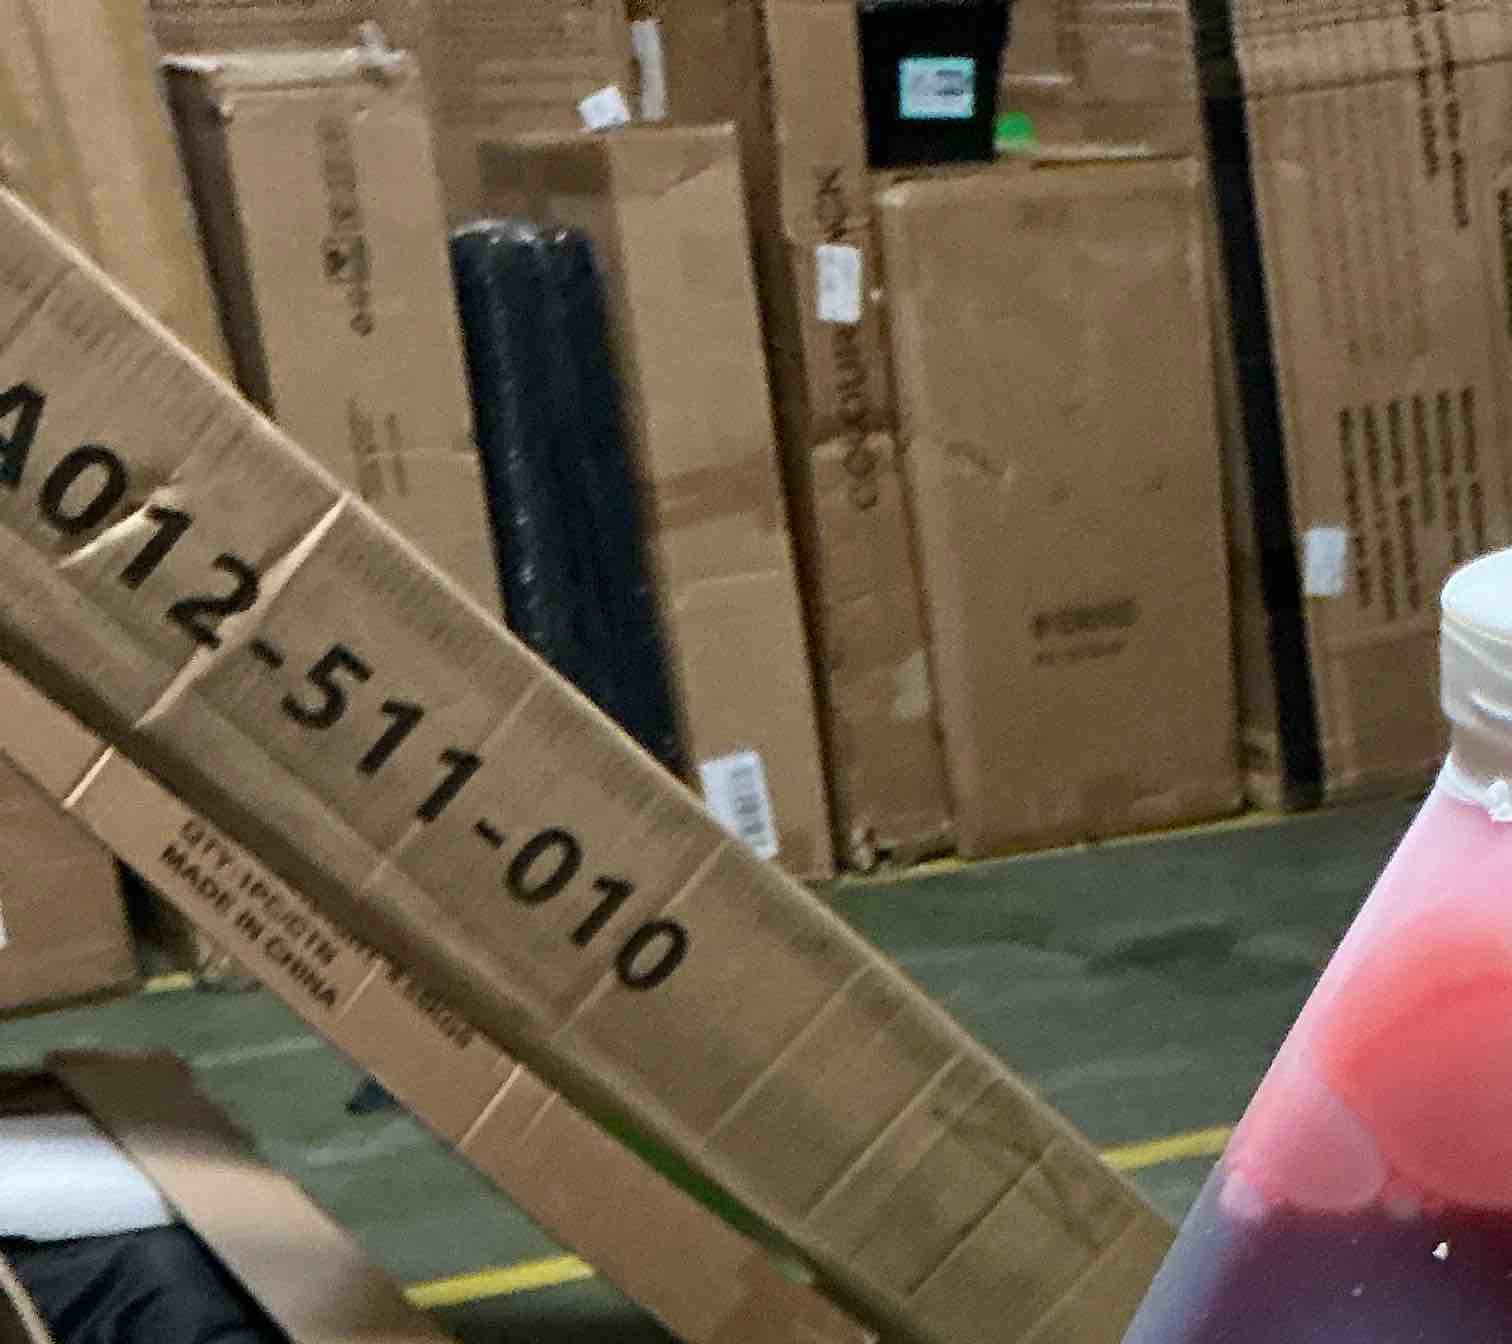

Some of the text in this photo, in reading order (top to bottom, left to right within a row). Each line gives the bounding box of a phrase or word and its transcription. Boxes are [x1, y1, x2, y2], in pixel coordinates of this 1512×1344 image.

[160, 843, 232, 914] MADE
[236, 910, 264, 940] IN
[265, 935, 336, 1009] CHINA
